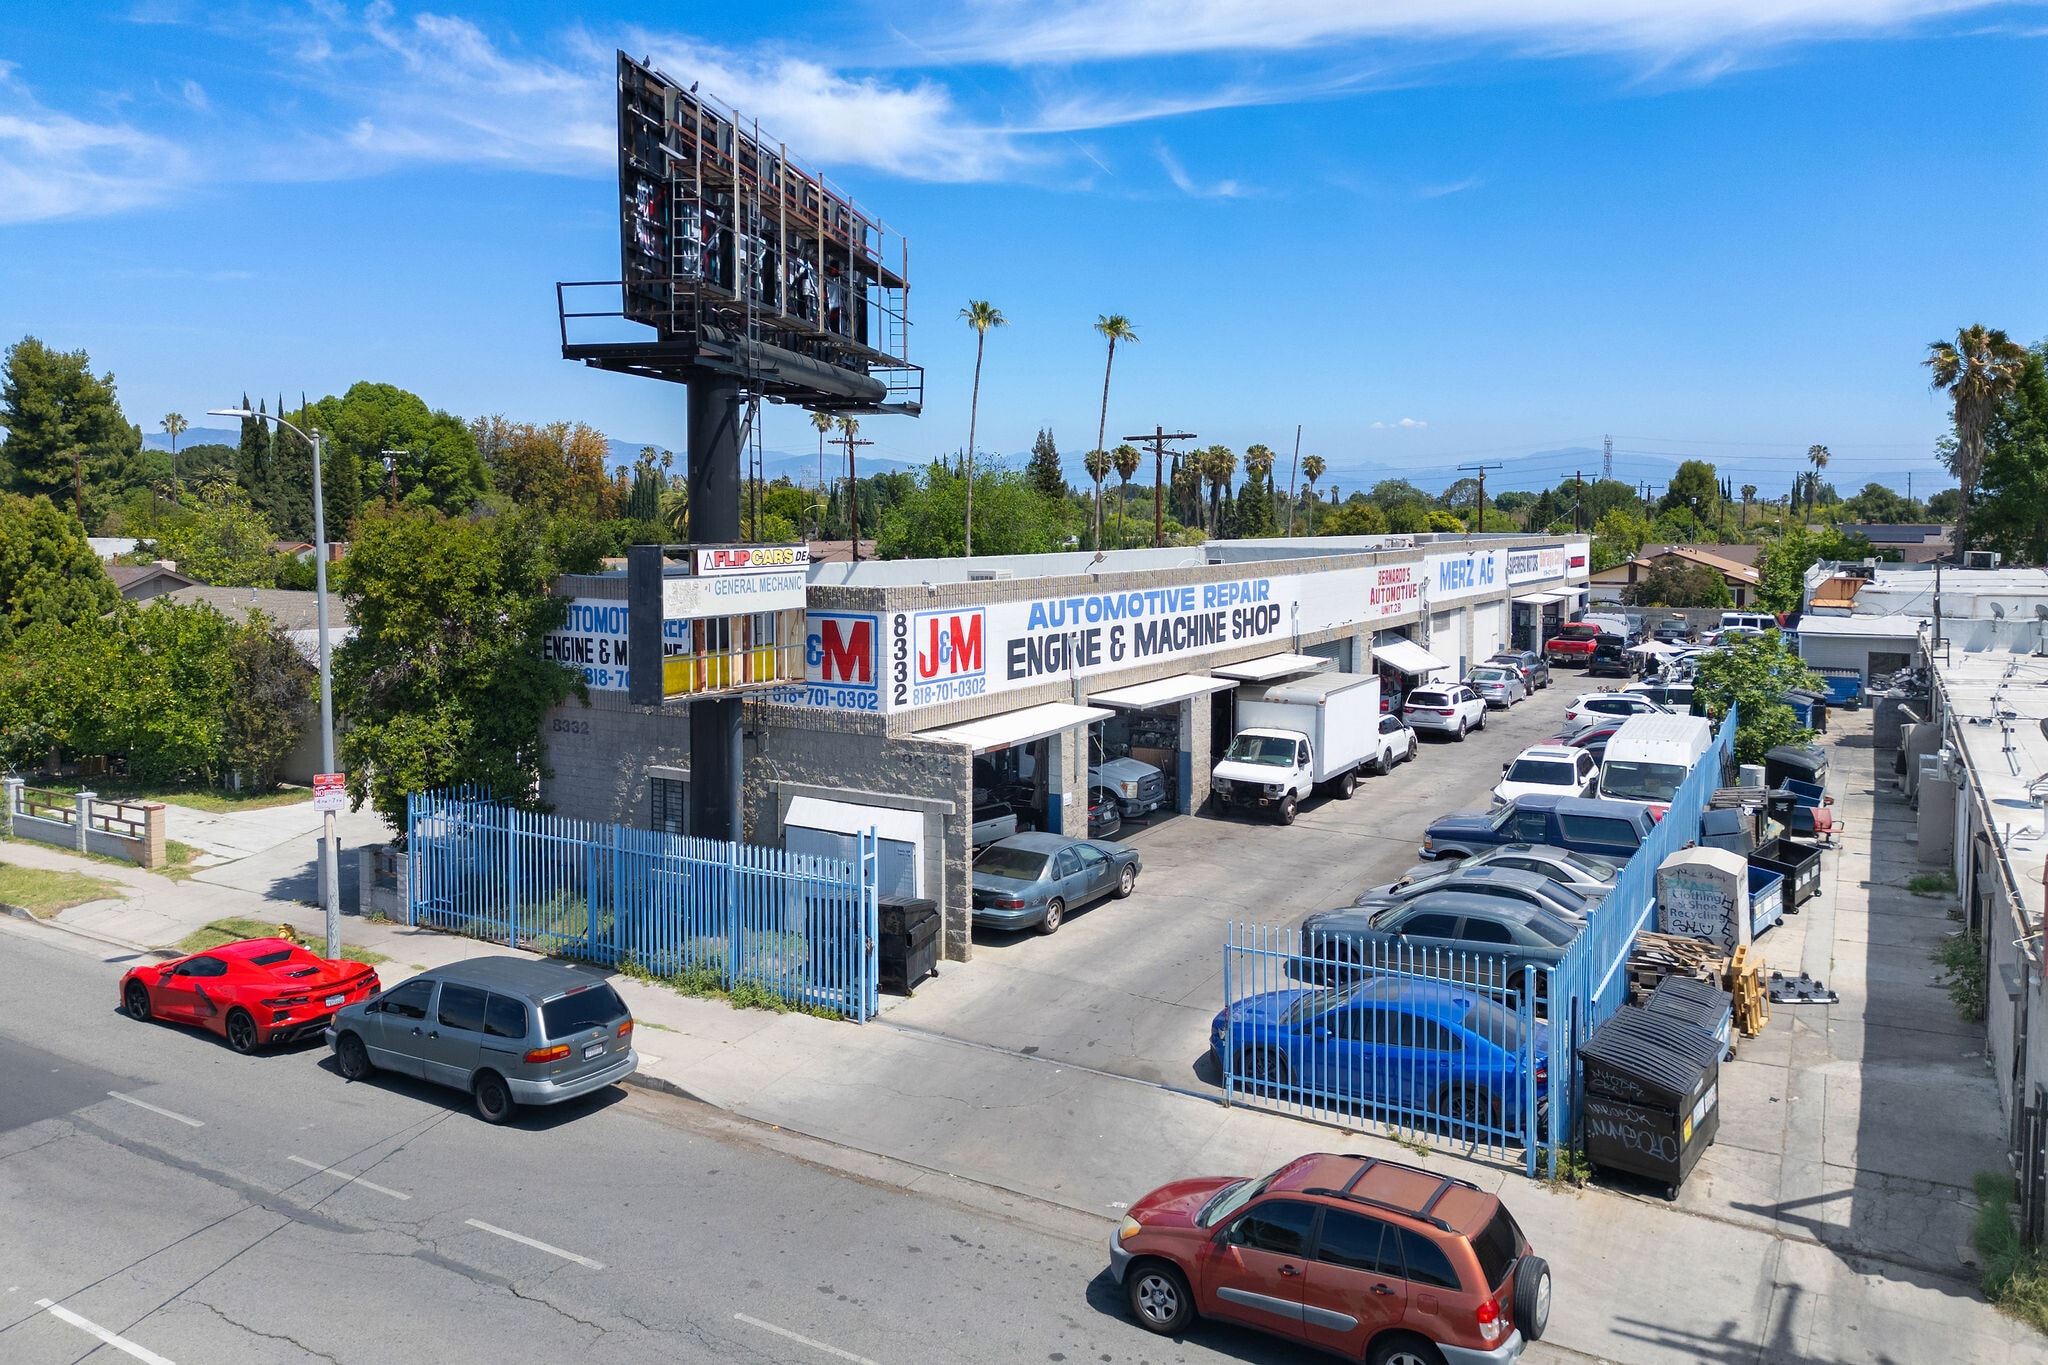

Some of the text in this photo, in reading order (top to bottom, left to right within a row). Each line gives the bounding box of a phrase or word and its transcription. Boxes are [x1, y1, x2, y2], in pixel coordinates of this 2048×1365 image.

[714, 577, 757, 596] GENERAL
[759, 575, 802, 593] MECHANIC
[1440, 557, 1494, 592] MERZ AG
[1027, 579, 1270, 631] AUTOMOTIVE REPAIR
[1370, 583, 1417, 605] AUTOMOTIVE
[543, 635, 593, 664] ENGINE
[599, 638, 611, 664] &
[919, 614, 981, 678] J&M
[1007, 603, 1280, 681] ENGINE & MACHINE SHOP
[913, 677, 986, 706] 818-701-0302
[552, 718, 590, 736] 8332
[1673, 889, 1721, 905] Clothing
[1689, 900, 1718, 911] Shoe
[1670, 908, 1725, 924] Recycling
